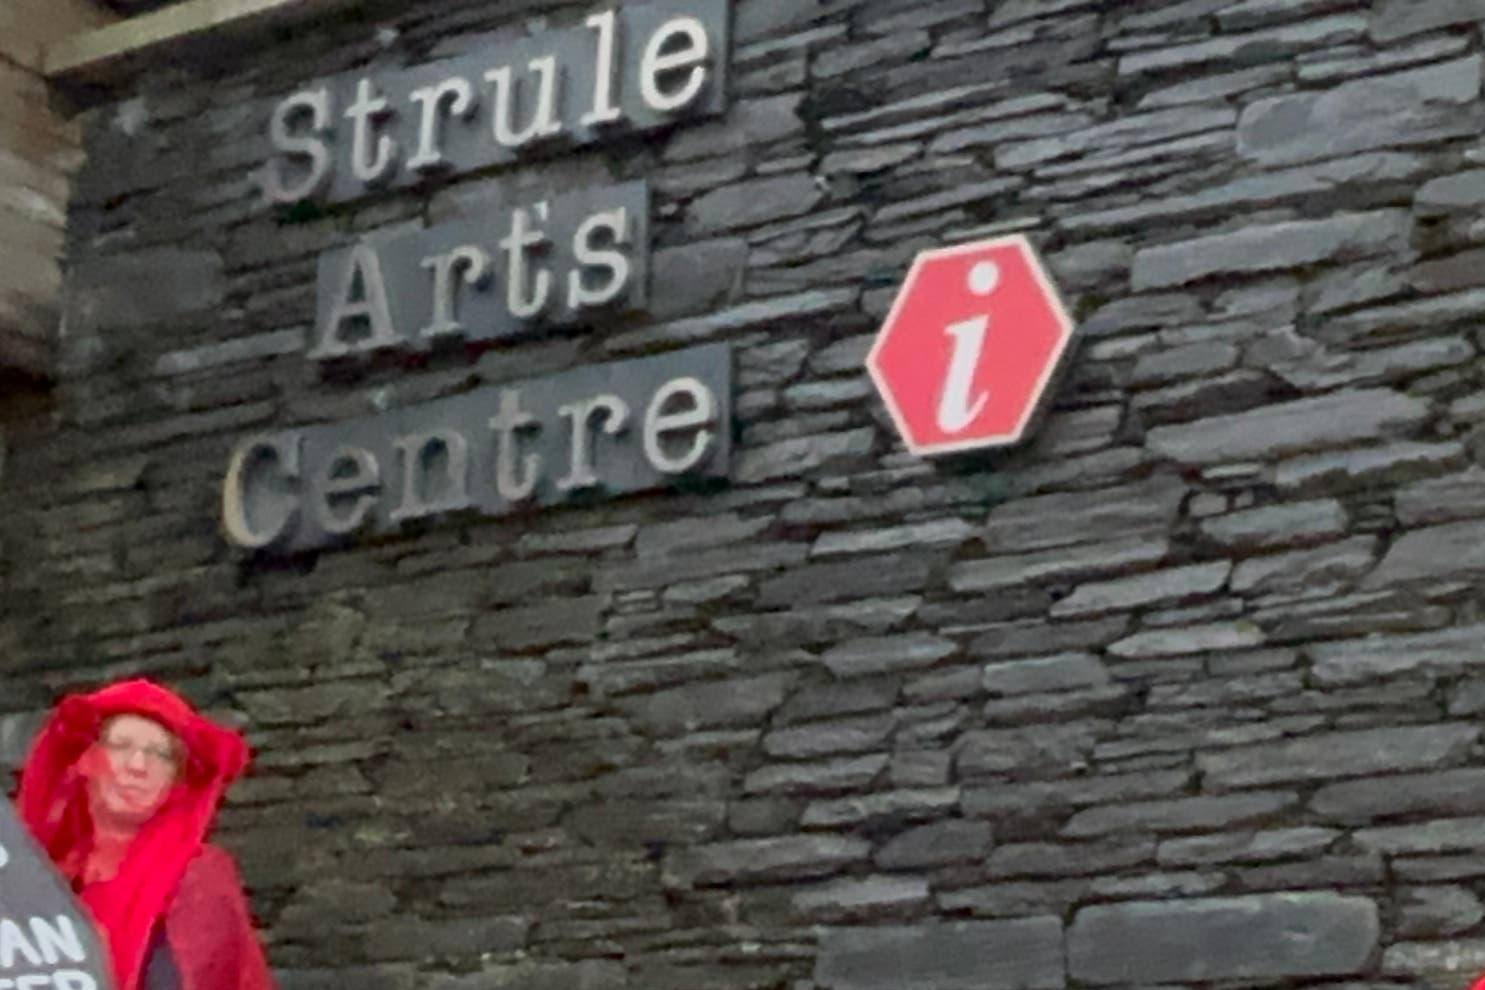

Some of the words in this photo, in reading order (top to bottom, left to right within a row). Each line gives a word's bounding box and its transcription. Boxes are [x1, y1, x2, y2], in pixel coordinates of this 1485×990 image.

[249, 10, 709, 204] Strule
[306, 206, 630, 360] Arts
[935, 261, 1000, 434] i
[222, 377, 717, 548] Centre
